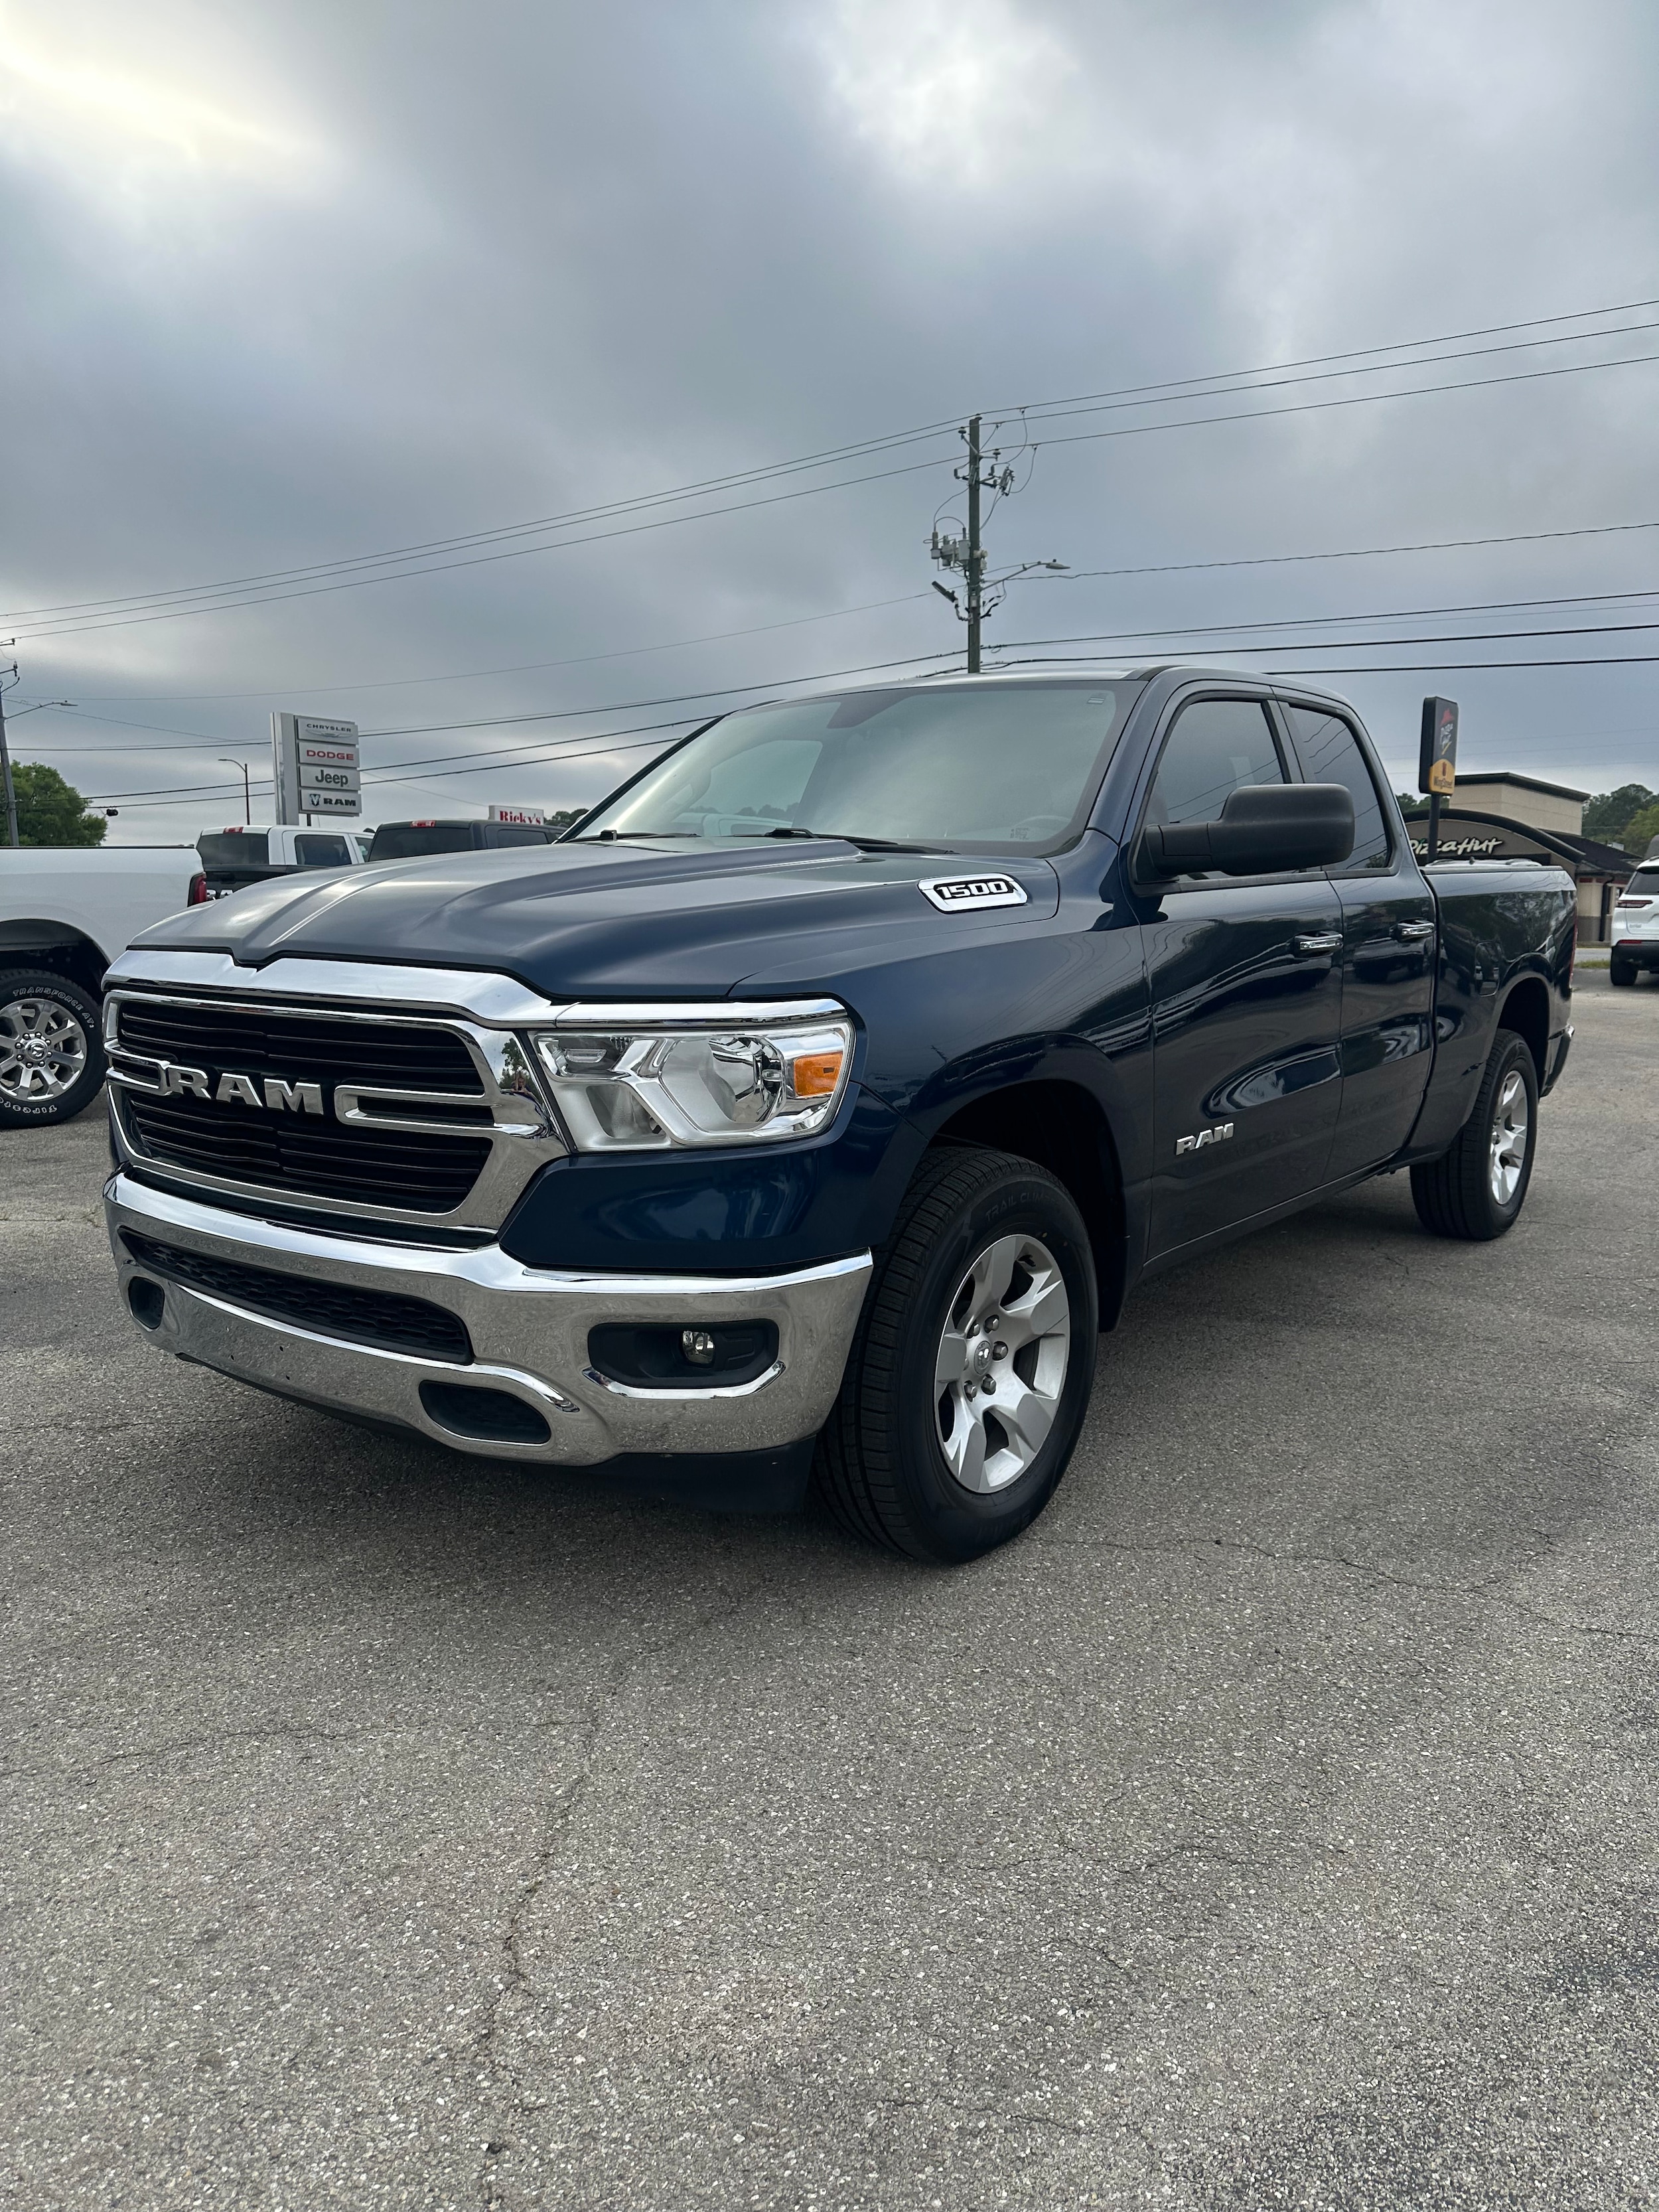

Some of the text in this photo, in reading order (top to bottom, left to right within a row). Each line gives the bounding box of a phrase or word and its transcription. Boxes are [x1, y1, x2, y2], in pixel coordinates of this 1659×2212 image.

[307, 723, 351, 733] CHRYSLER
[307, 749, 354, 761] DODGE
[315, 769, 348, 787] Jeep
[323, 798, 356, 806] RAM
[500, 810, 541, 825] Ricky's
[936, 881, 1009, 899] 1500
[13, 986, 84, 1011] TRANSFORCE
[167, 1064, 324, 1116] RAM
[1175, 1122, 1234, 1155] RAM
